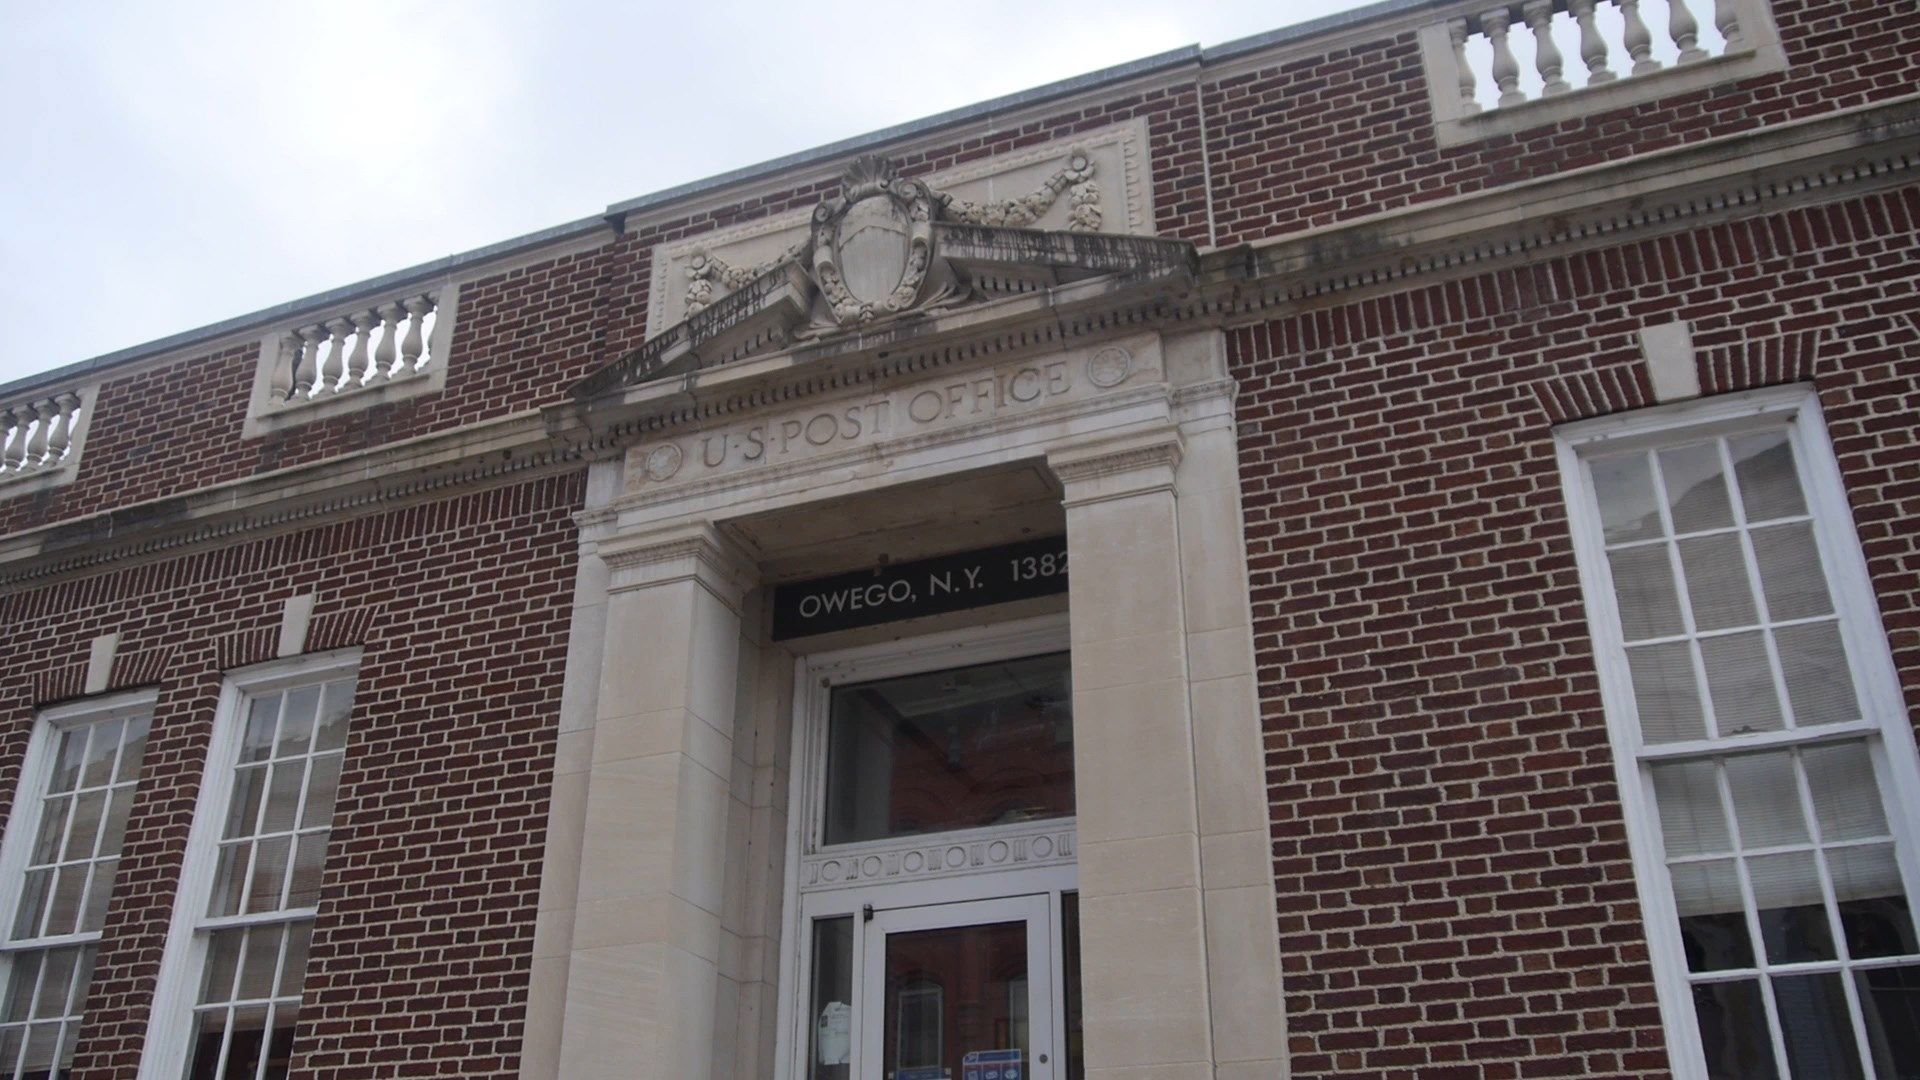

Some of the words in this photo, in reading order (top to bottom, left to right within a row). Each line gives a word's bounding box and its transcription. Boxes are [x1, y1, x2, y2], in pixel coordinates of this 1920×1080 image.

[909, 360, 1072, 424] OFFICE
[799, 579, 916, 618] OWEGO,
[929, 566, 983, 596] N.Y.
